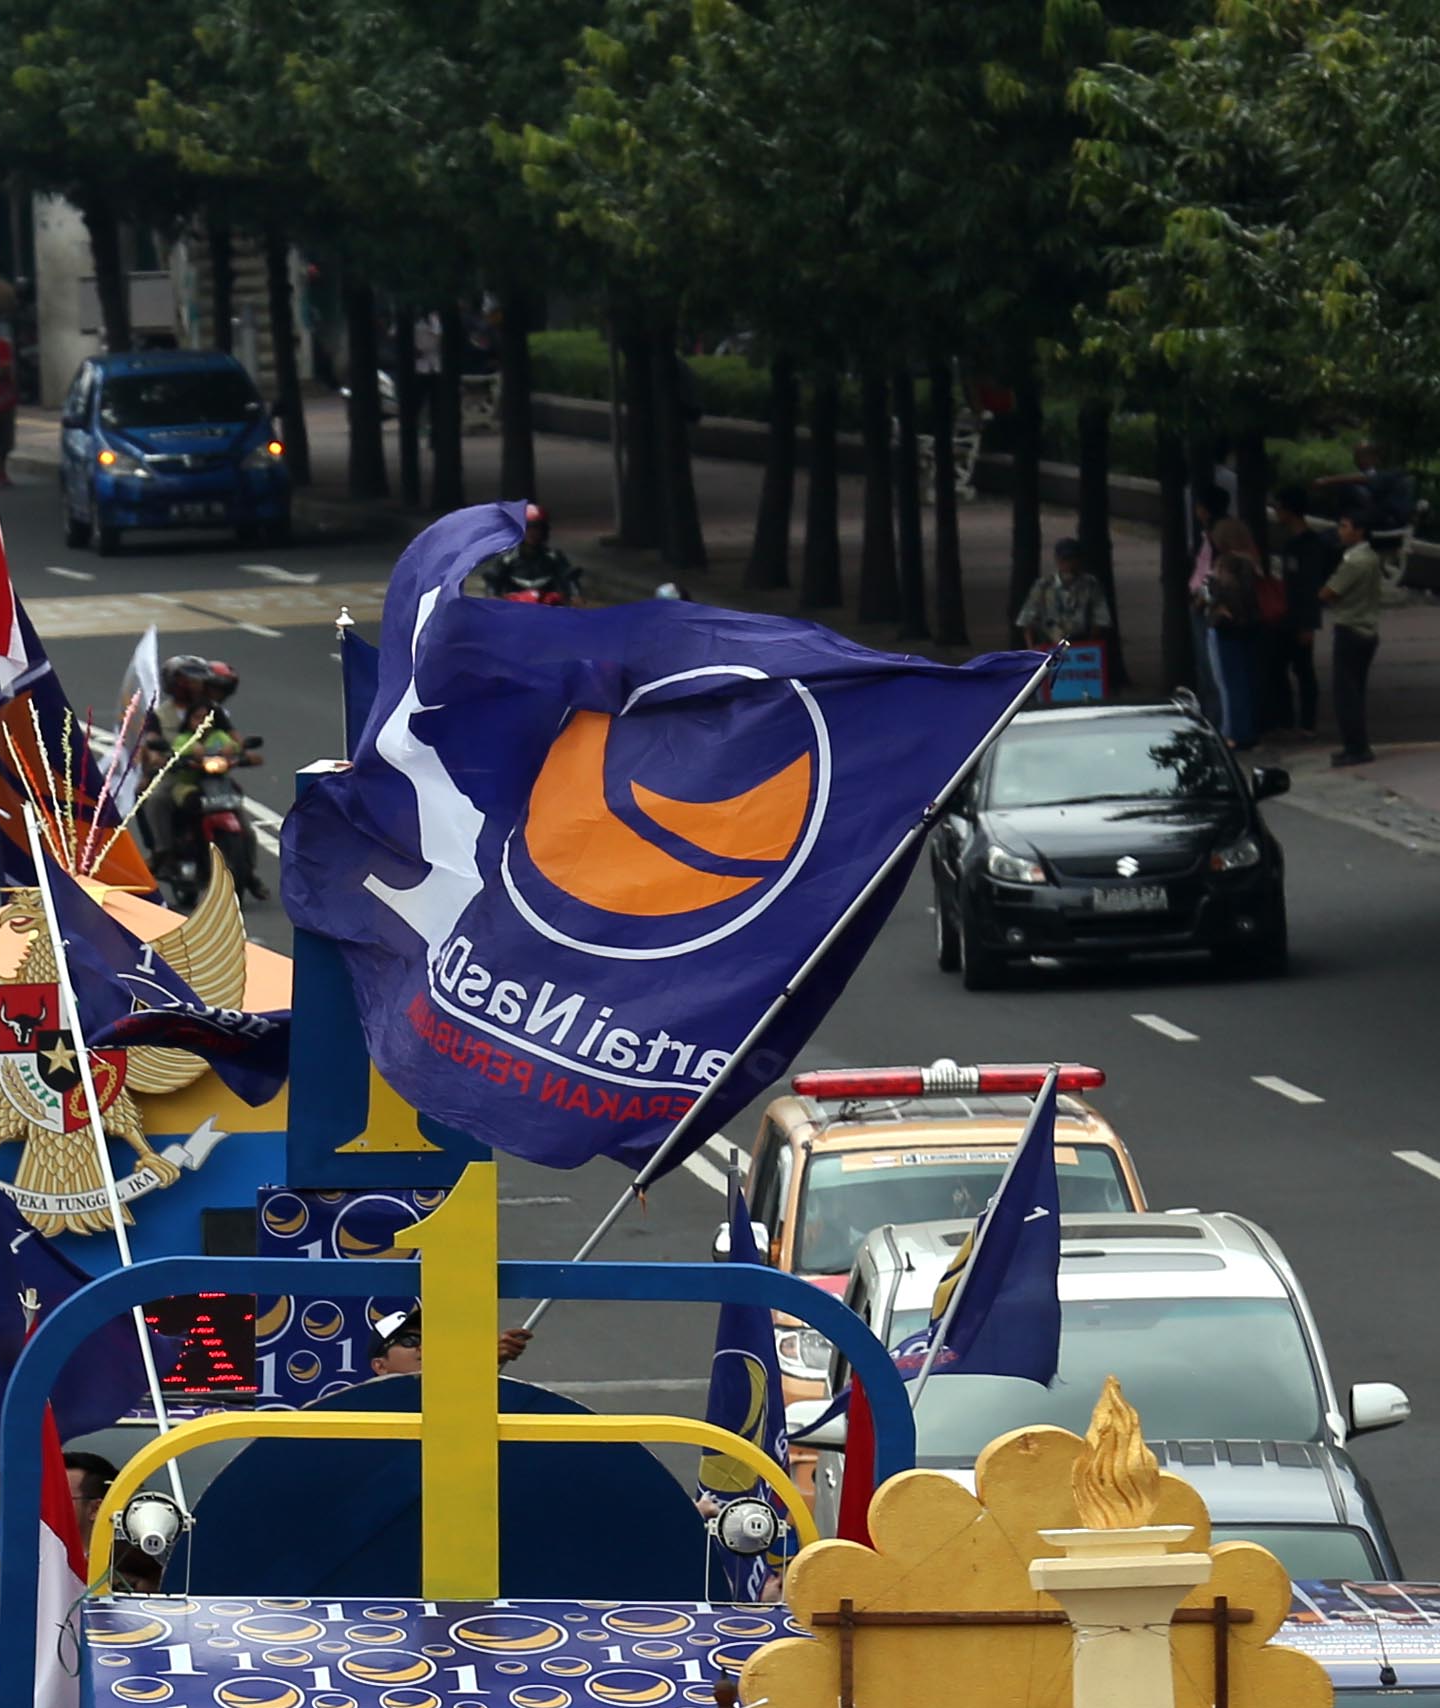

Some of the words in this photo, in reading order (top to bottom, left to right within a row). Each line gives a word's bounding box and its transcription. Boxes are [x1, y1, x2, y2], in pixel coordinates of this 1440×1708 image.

[55, 1189, 125, 1212] TUNGGL
[128, 1171, 155, 1194] IKA
[255, 1352, 283, 1398] 1
[335, 1338, 358, 1373] 1
